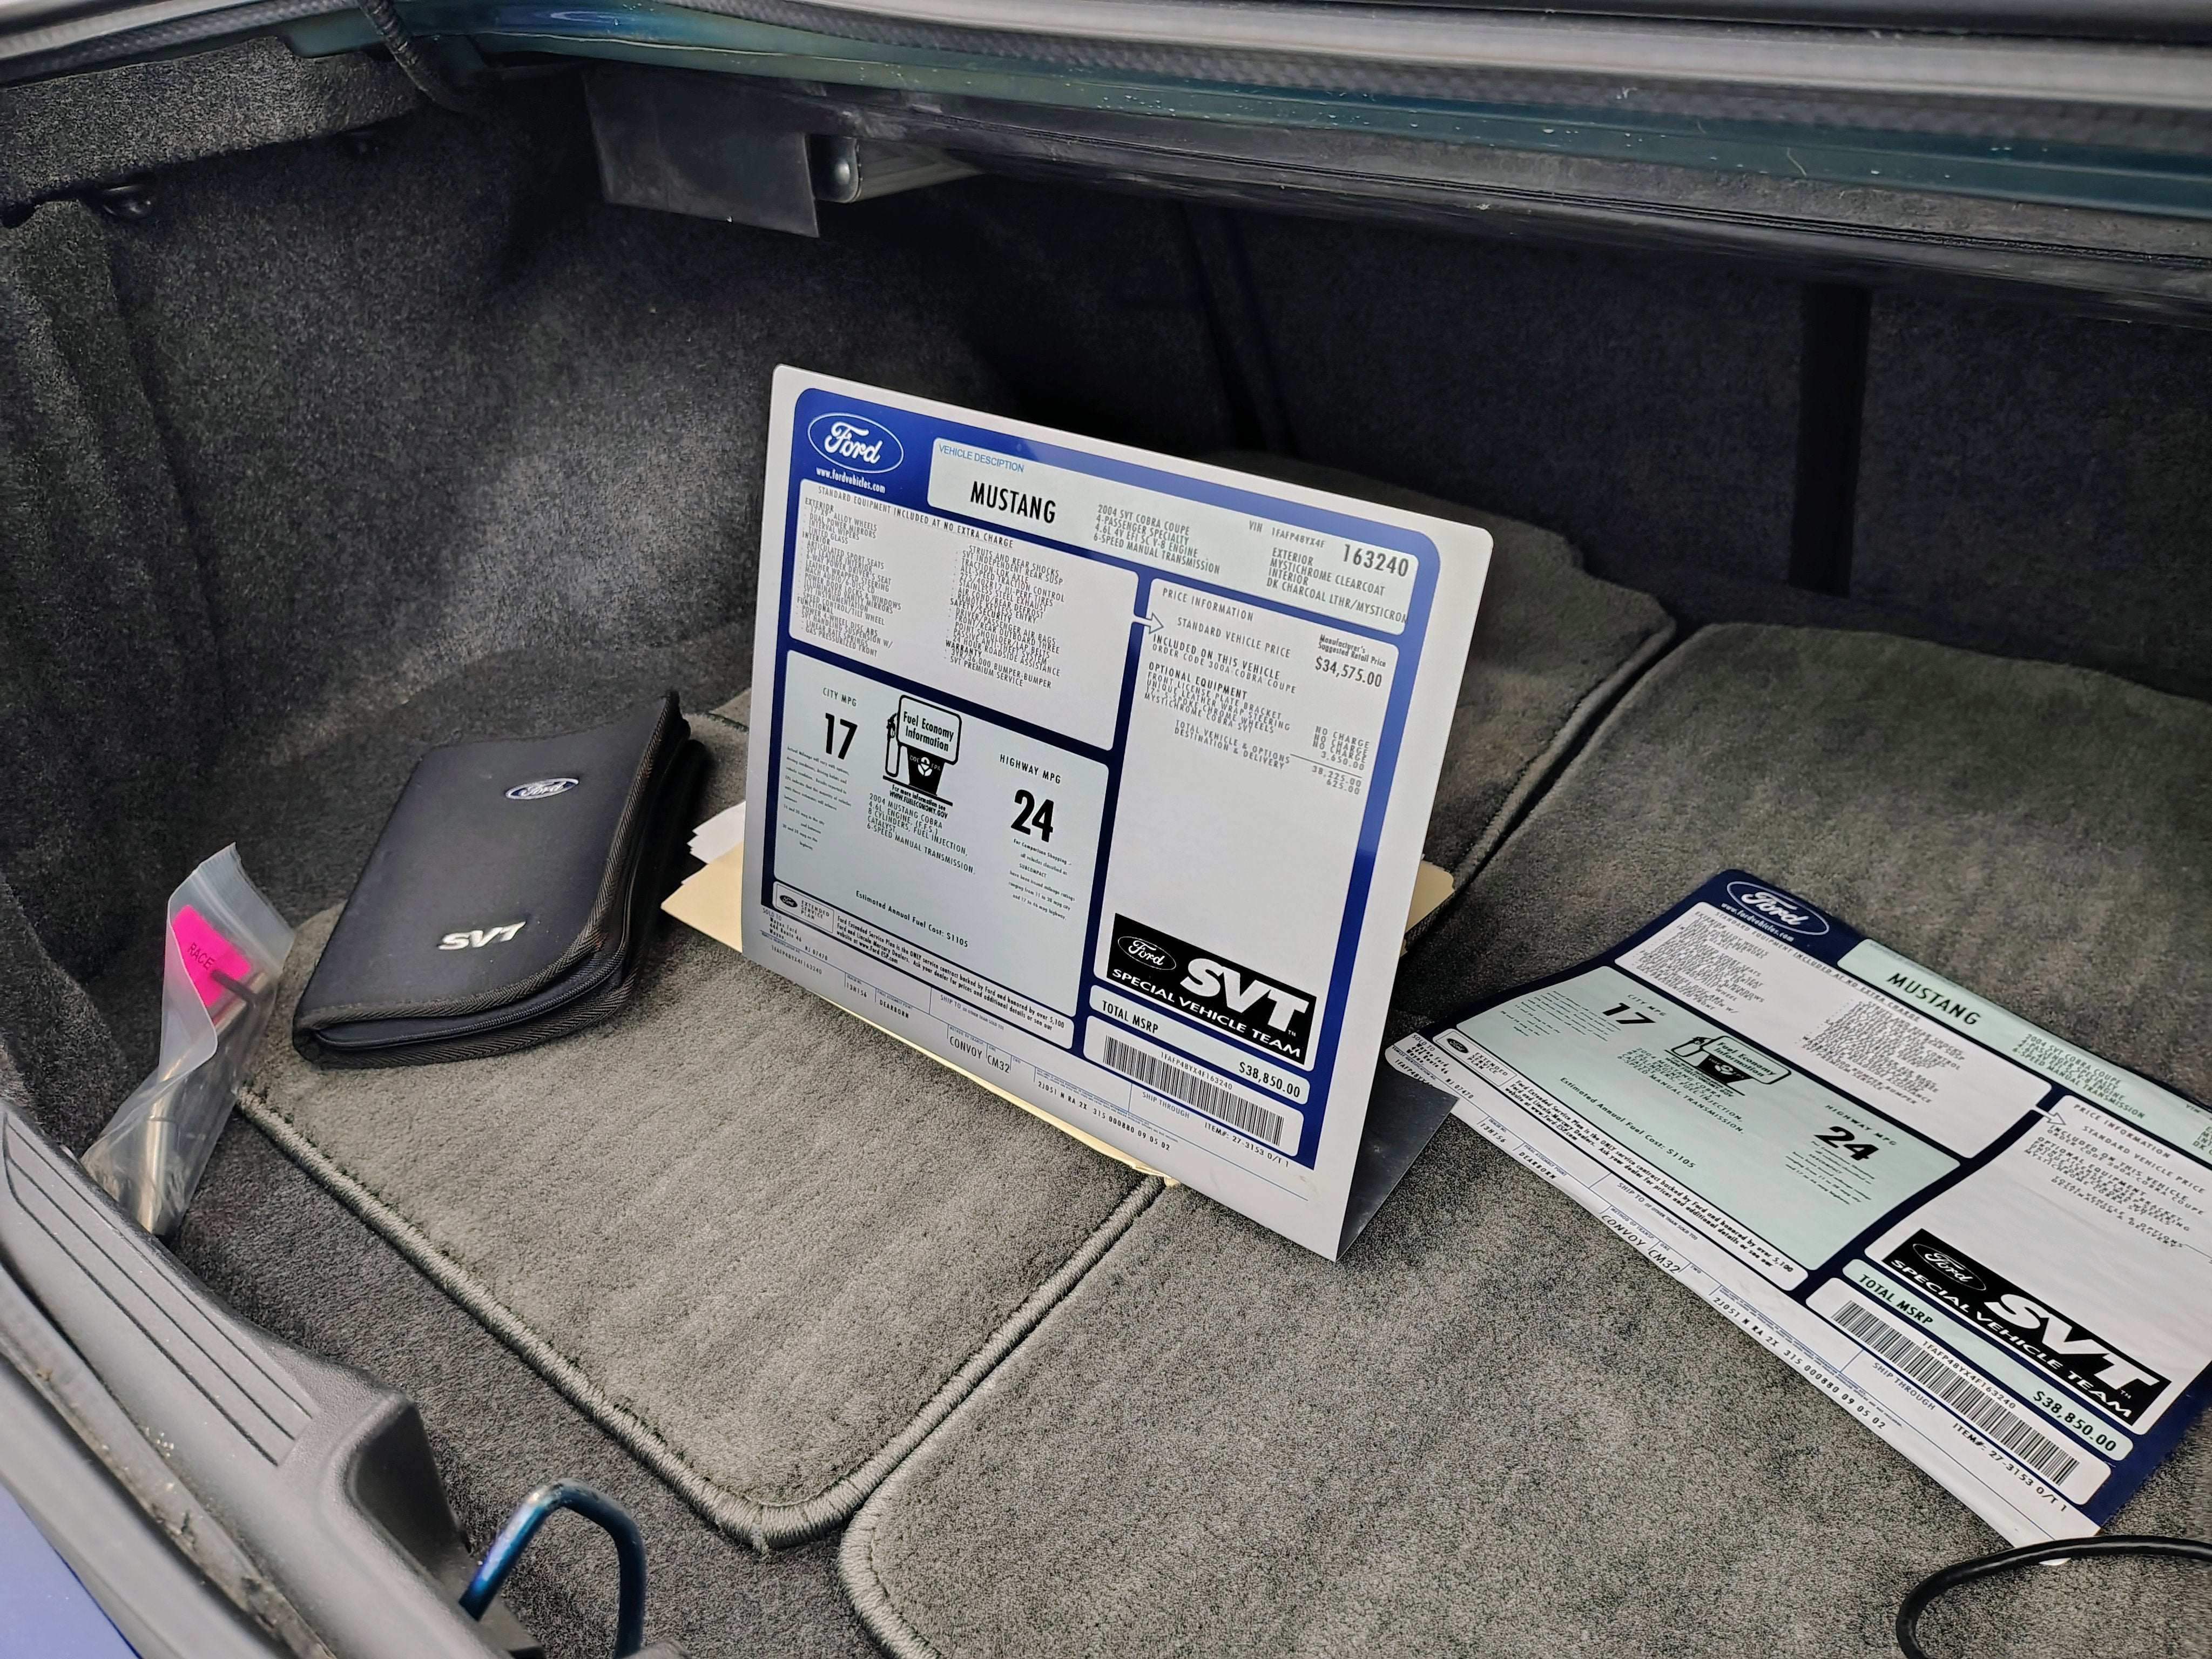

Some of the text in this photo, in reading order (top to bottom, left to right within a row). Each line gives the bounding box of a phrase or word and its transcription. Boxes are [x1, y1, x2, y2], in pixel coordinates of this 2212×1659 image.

[824, 421, 883, 464] Ford
[939, 444, 1024, 473] VEHICLE DESCIPTION
[816, 467, 886, 494] www.fordvehicles.com
[818, 485, 1013, 549] STANDARD EQUIPMENT INCLUDED AT NO EXTRA CHARGE
[970, 481, 1056, 524] MUSTANG
[807, 526, 848, 545] TINTED GLASS
[833, 512, 877, 532] ALLOY WHEELS
[1096, 514, 1190, 546] 4-PASSENGER SPECIALTY
[1097, 504, 1190, 536] 2004 SVT COBRA COUPE
[1249, 520, 1264, 534] VIN
[807, 539, 884, 570] ARTICULATED SPORT SEATS
[969, 545, 1061, 579] STRUTS AND REAR SHOCKS
[1093, 532, 1220, 575] 6-SPEED MANUAL TRANSMISSION
[1272, 547, 1314, 567] EXTERIOR
[1343, 543, 1409, 577] 163240
[804, 572, 901, 610] POWER DOOR LOCKS & WINDOWS
[1265, 576, 1326, 602] DK CHARCOAL
[1268, 567, 1309, 586] INTERIOR
[1270, 557, 1386, 597] MYSTICHROME CLEARCOAT
[1162, 587, 1253, 622] PRICE INFORMATION
[805, 625, 878, 657] GAS PRESSURIZED FRONT
[946, 639, 982, 658] WARRANTY
[1177, 617, 1291, 658] STANDARD VEHICLE PRICE
[949, 655, 1023, 687] SVT PREMIUM SERVICE
[1153, 633, 1280, 680] INCLUDED ON THIS VEHICLE
[1315, 656, 1382, 687] $34,575.00
[822, 686, 857, 707] CITY MPG
[1149, 662, 1247, 700] OPTIONAL EQUIPMENT
[825, 712, 858, 760] 17
[902, 710, 954, 742] Fuel Economy
[905, 725, 949, 752] Information
[1000, 754, 1061, 784] HIGHWAY MPG
[869, 792, 942, 830] 2004 MUSTANG COBRA
[1010, 789, 1054, 843] 24
[867, 822, 893, 839] 6-SPEED
[895, 834, 922, 852] MANUAL
[800, 909, 815, 921] PLAN
[801, 900, 830, 917] EXTENDED
[801, 905, 824, 919] SERVICE
[856, 890, 886, 909] Estimated
[888, 905, 910, 921] Annual
[912, 915, 927, 929] Fuel
[1741, 891, 1809, 927] Ford
[438, 921, 526, 950] SVT
[187, 942, 215, 970] RACE
[1128, 938, 1164, 966] Ford
[879, 999, 909, 1019] DEARBORN
[940, 994, 962, 1010] SHIP TO
[1180, 958, 1309, 1033] SVT
[1627, 994, 1666, 1016] CITY MPG
[1887, 973, 1981, 1024] MUSTANG
[1102, 1000, 1158, 1034] TOTAL MSRP
[1112, 969, 1300, 1057] SPECIAL VEHICLE TEAM
[1602, 1002, 1656, 1024] 17
[949, 1036, 982, 1059] CONVOY
[986, 1053, 1011, 1074] CM32
[1714, 1048, 1764, 1077] Information
[1717, 1042, 1776, 1076] Fuel Economy
[1161, 1051, 1232, 1090] 1FAFP48YX4F163240
[1239, 1061, 1300, 1098] $38,850.00
[1038, 1081, 1170, 1151] 2J051 N RA 2X 315 000880 09 05 02
[1142, 1091, 1190, 1119] SHIP THROUGH
[1825, 1105, 1896, 1145] HIGHWAY MPG
[1813, 1126, 1879, 1161] 24
[1517, 1150, 1558, 1181] DEARBORN
[1601, 1215, 1647, 1247] CONVOY
[1647, 1249, 1681, 1274] CM32
[1925, 1250, 1974, 1283] Ford
[1859, 1274, 1933, 1324] TOTAL MSRP
[1891, 1259, 2132, 1418] SPECIAL VEHICLE TEAM
[1984, 1294, 2161, 1391] SVT
[1871, 1361, 1937, 1411] SHIP THROUGH
[2033, 1391, 2116, 1451] $38,850.00
